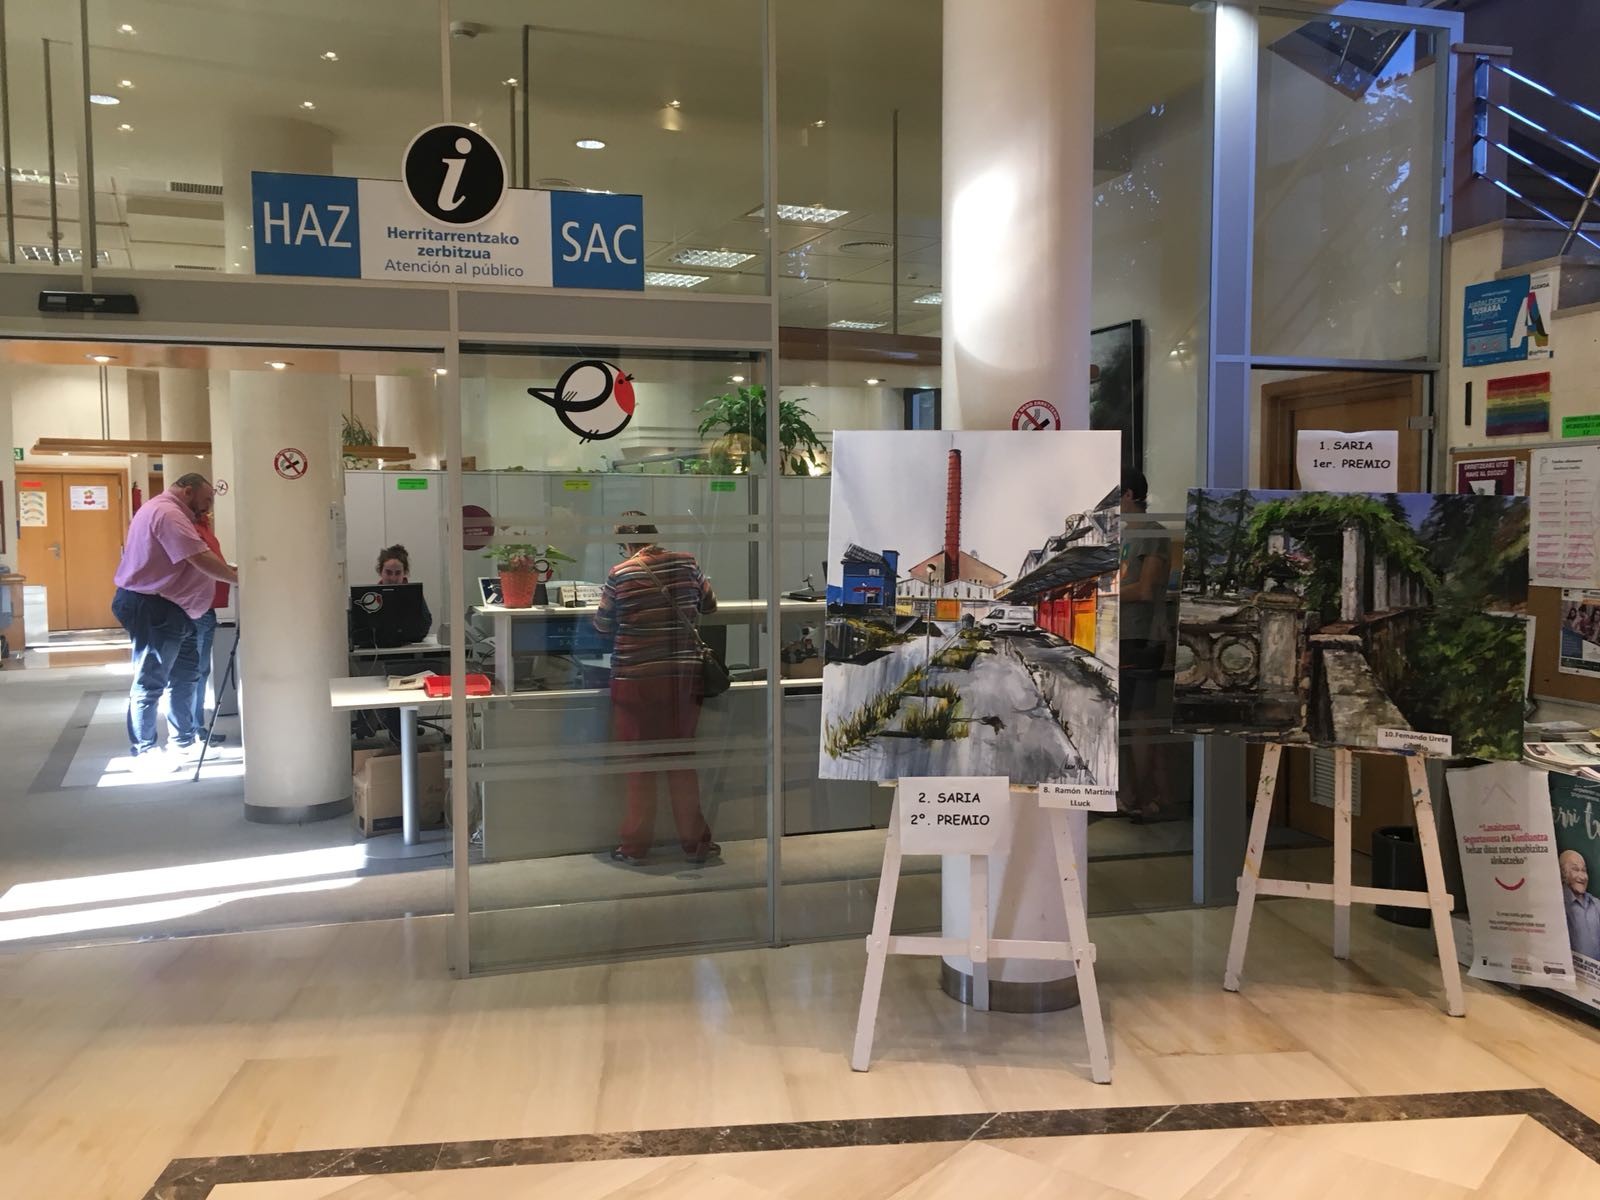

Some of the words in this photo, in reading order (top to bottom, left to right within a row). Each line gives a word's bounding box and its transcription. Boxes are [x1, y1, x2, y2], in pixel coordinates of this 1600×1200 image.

[263, 200, 352, 249] HAZ
[387, 226, 520, 246] Herritarrentzako
[561, 220, 638, 265] SAC
[417, 243, 492, 260] zerbitzua
[384, 257, 451, 275] Atención
[454, 261, 469, 276] al
[472, 262, 524, 278] público
[1319, 441, 1330, 450] 1.
[1333, 441, 1374, 450] SARIA
[1313, 459, 1336, 469] 1er.
[1341, 459, 1391, 469] PREMIO
[918, 792, 931, 803] 2.
[937, 792, 981, 803] SARIA
[1055, 786, 1081, 795] Ramón
[937, 814, 990, 826] PREMIO
